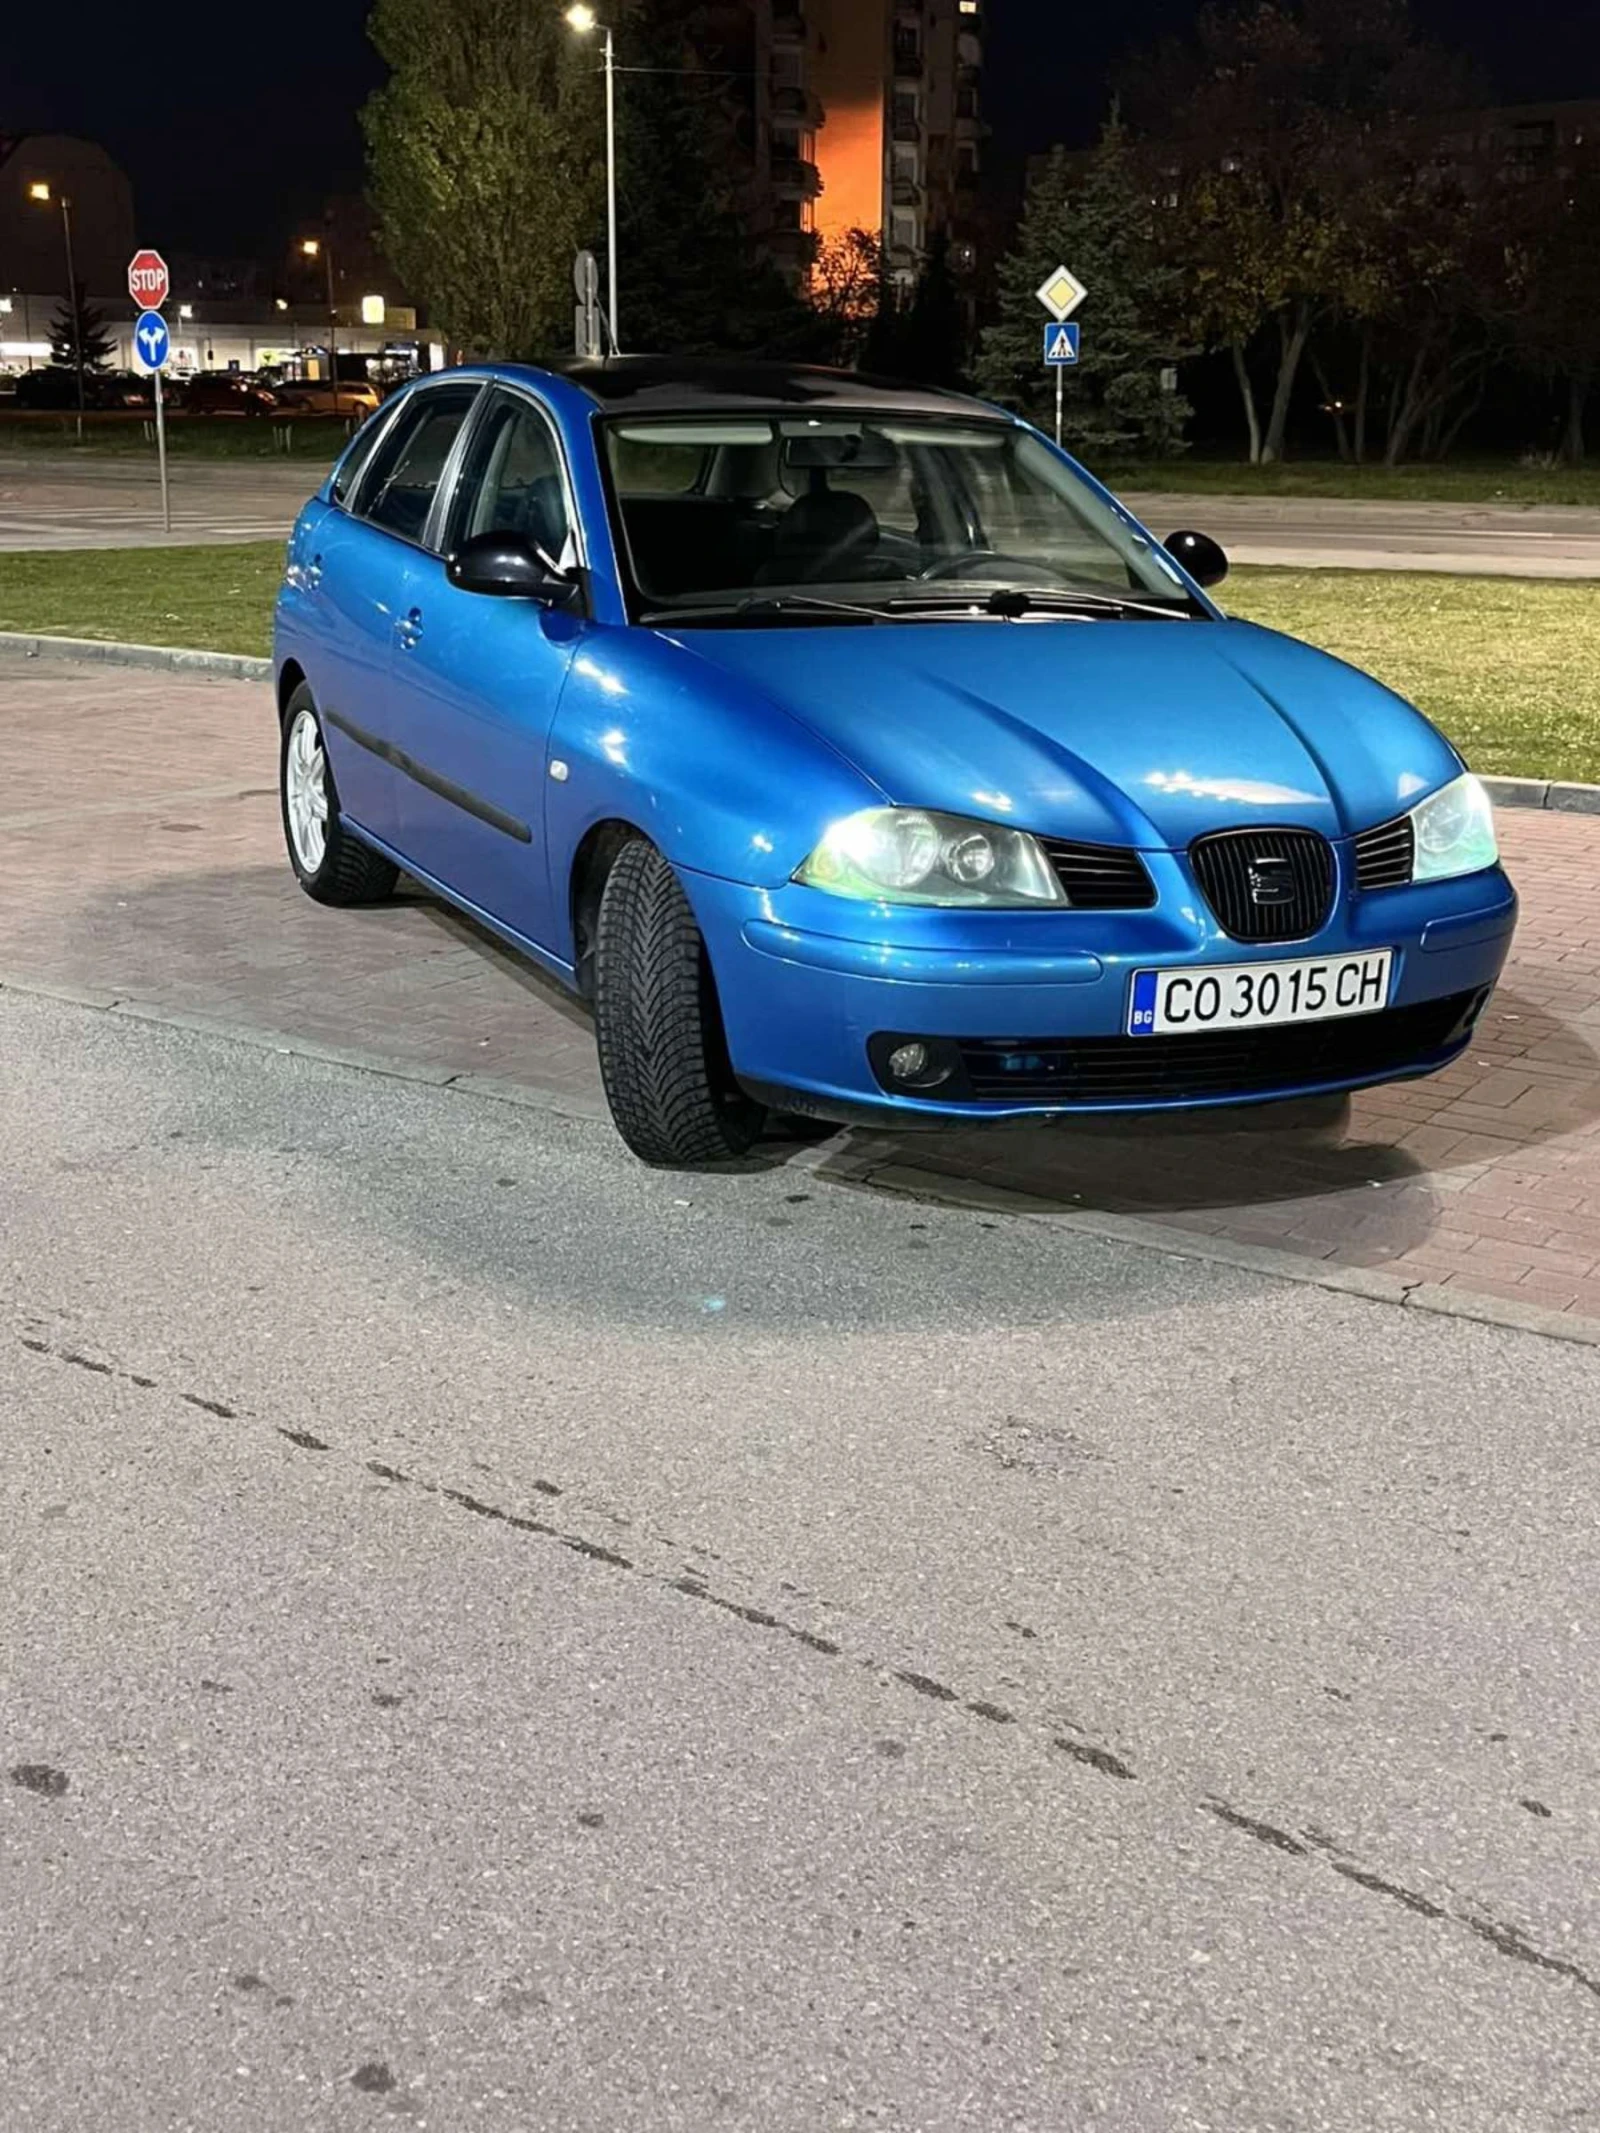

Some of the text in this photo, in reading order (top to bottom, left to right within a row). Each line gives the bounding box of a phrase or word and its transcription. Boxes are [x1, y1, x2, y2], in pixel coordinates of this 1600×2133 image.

[131, 269, 165, 291] STOP
[1164, 958, 1384, 1023] CO 3015 CH
[1133, 1010, 1153, 1025] BG
